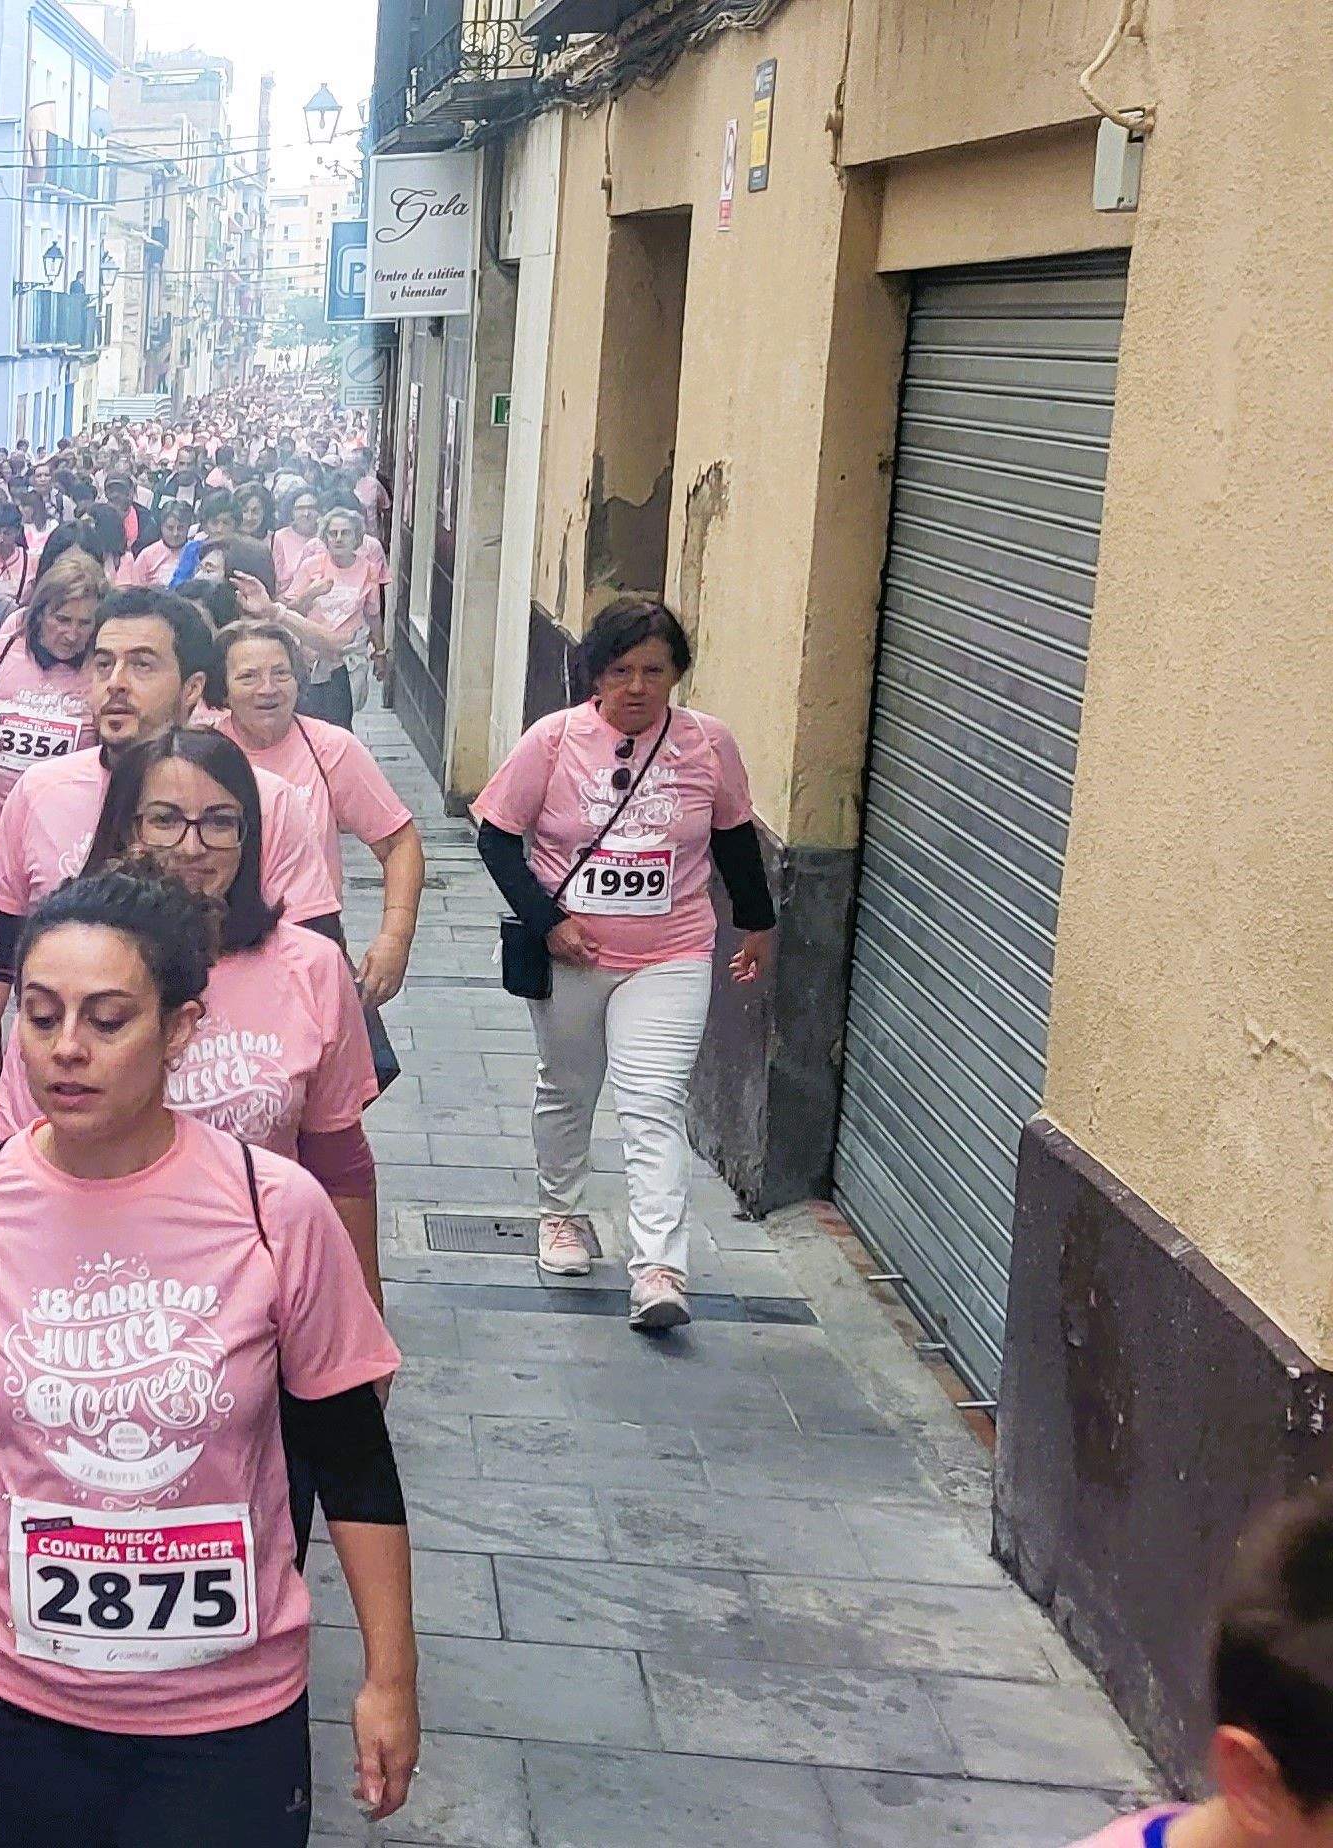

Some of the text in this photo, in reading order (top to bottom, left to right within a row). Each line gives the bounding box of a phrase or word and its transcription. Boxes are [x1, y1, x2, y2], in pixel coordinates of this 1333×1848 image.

[375, 188, 469, 243] Gala
[349, 262, 367, 296] P
[374, 267, 465, 282] Centro de estética
[389, 286, 448, 301] y bienestar
[2, 729, 70, 758] 3354
[582, 867, 665, 897] 1999
[168, 1056, 250, 1103] UESCA
[73, 1278, 201, 1321] CARRERA
[41, 1306, 171, 1369] HUESCA
[38, 1537, 234, 1562] CONTRA EL CÁNCER
[104, 1531, 164, 1545] HUESCA
[36, 1565, 237, 1631] 2875
